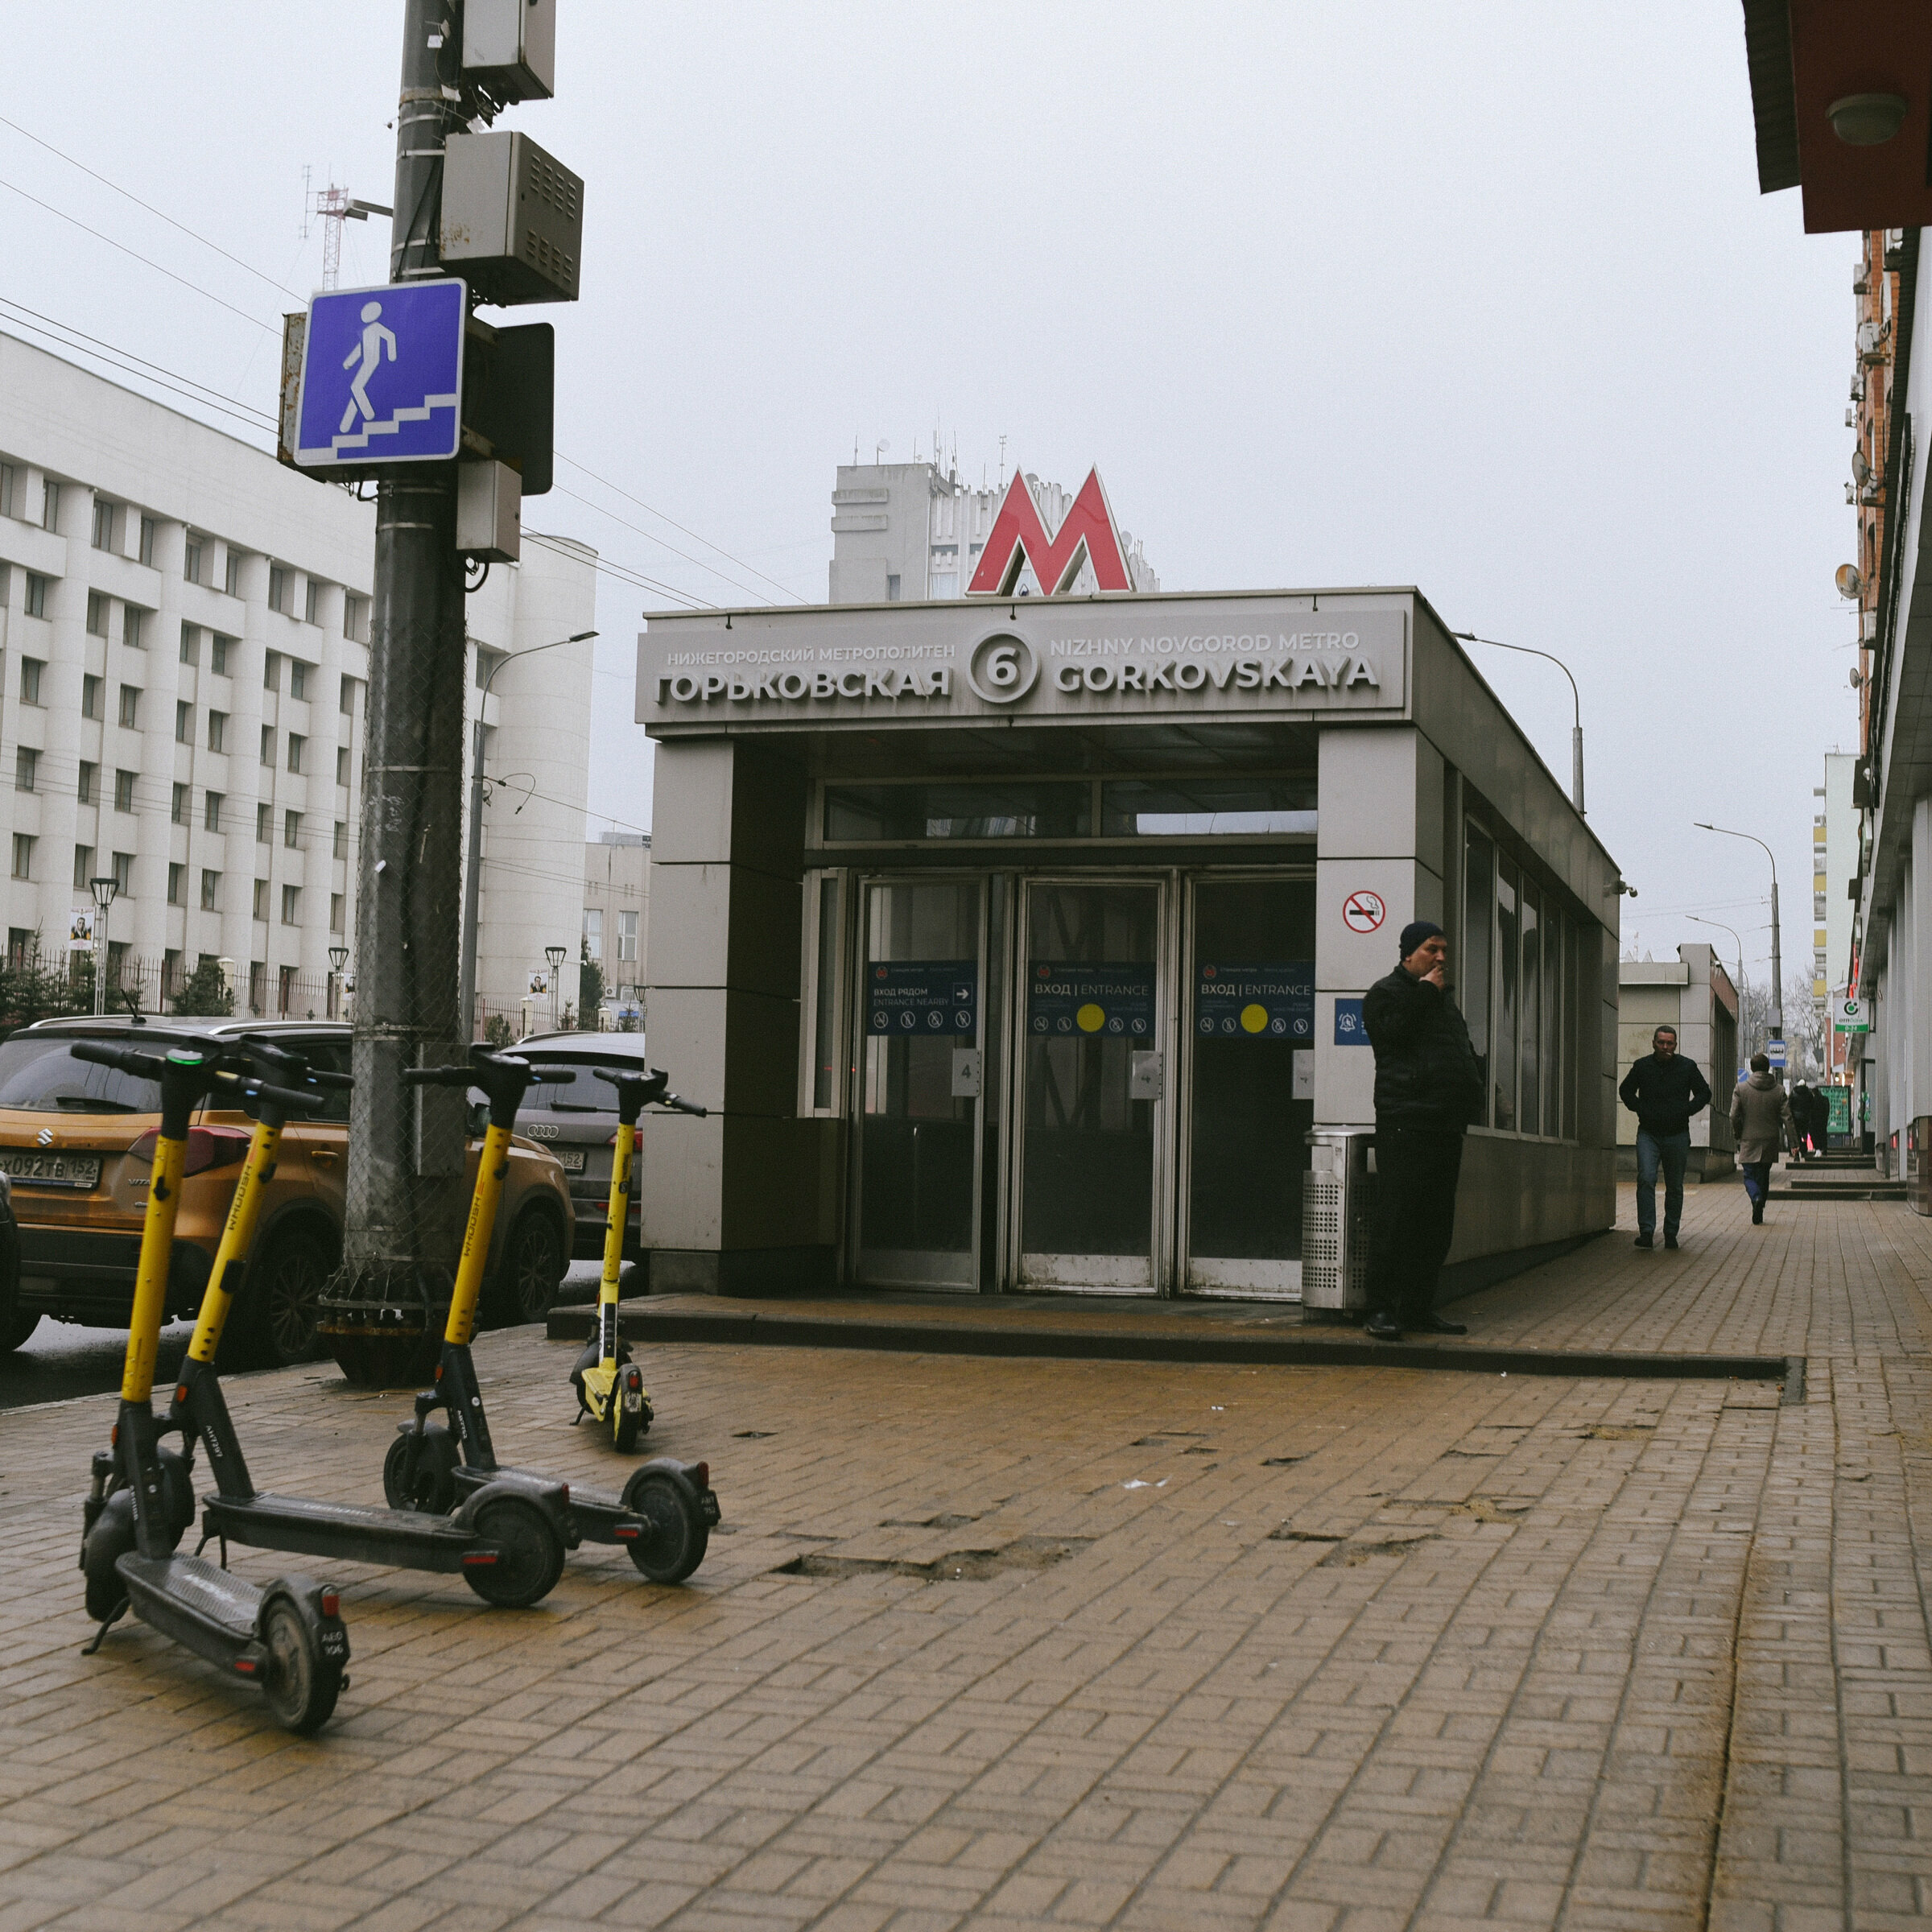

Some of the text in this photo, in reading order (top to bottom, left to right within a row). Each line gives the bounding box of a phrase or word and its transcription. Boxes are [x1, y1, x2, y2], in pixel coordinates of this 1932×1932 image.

[1050, 631, 1360, 657] NIZHNY NOVGOROD METRO
[667, 645, 956, 666] НИЖЕГОРОДСКИЙ МЕТРОПОЛИТЕН
[986, 646, 1020, 686] 6
[1053, 654, 1379, 692] GORKOVSKAYA
[654, 666, 952, 704] ГОРЬКОВСКАЯ
[873, 988, 928, 997] ВХОД РЯДОМ
[1034, 984, 1071, 996] ВХОД
[1080, 985, 1150, 996] ENTRANCE
[1201, 984, 1236, 996] ВХОД
[1245, 985, 1311, 996] ENTRANCE
[873, 997, 950, 1006] ENTRANCE NEARBY
[961, 1063, 972, 1079] 4
[70, 1158, 93, 1175] 152
[561, 1152, 580, 1165] 152
[228, 1165, 253, 1231] WHOOSH
[464, 1196, 482, 1257] WHOOSH
